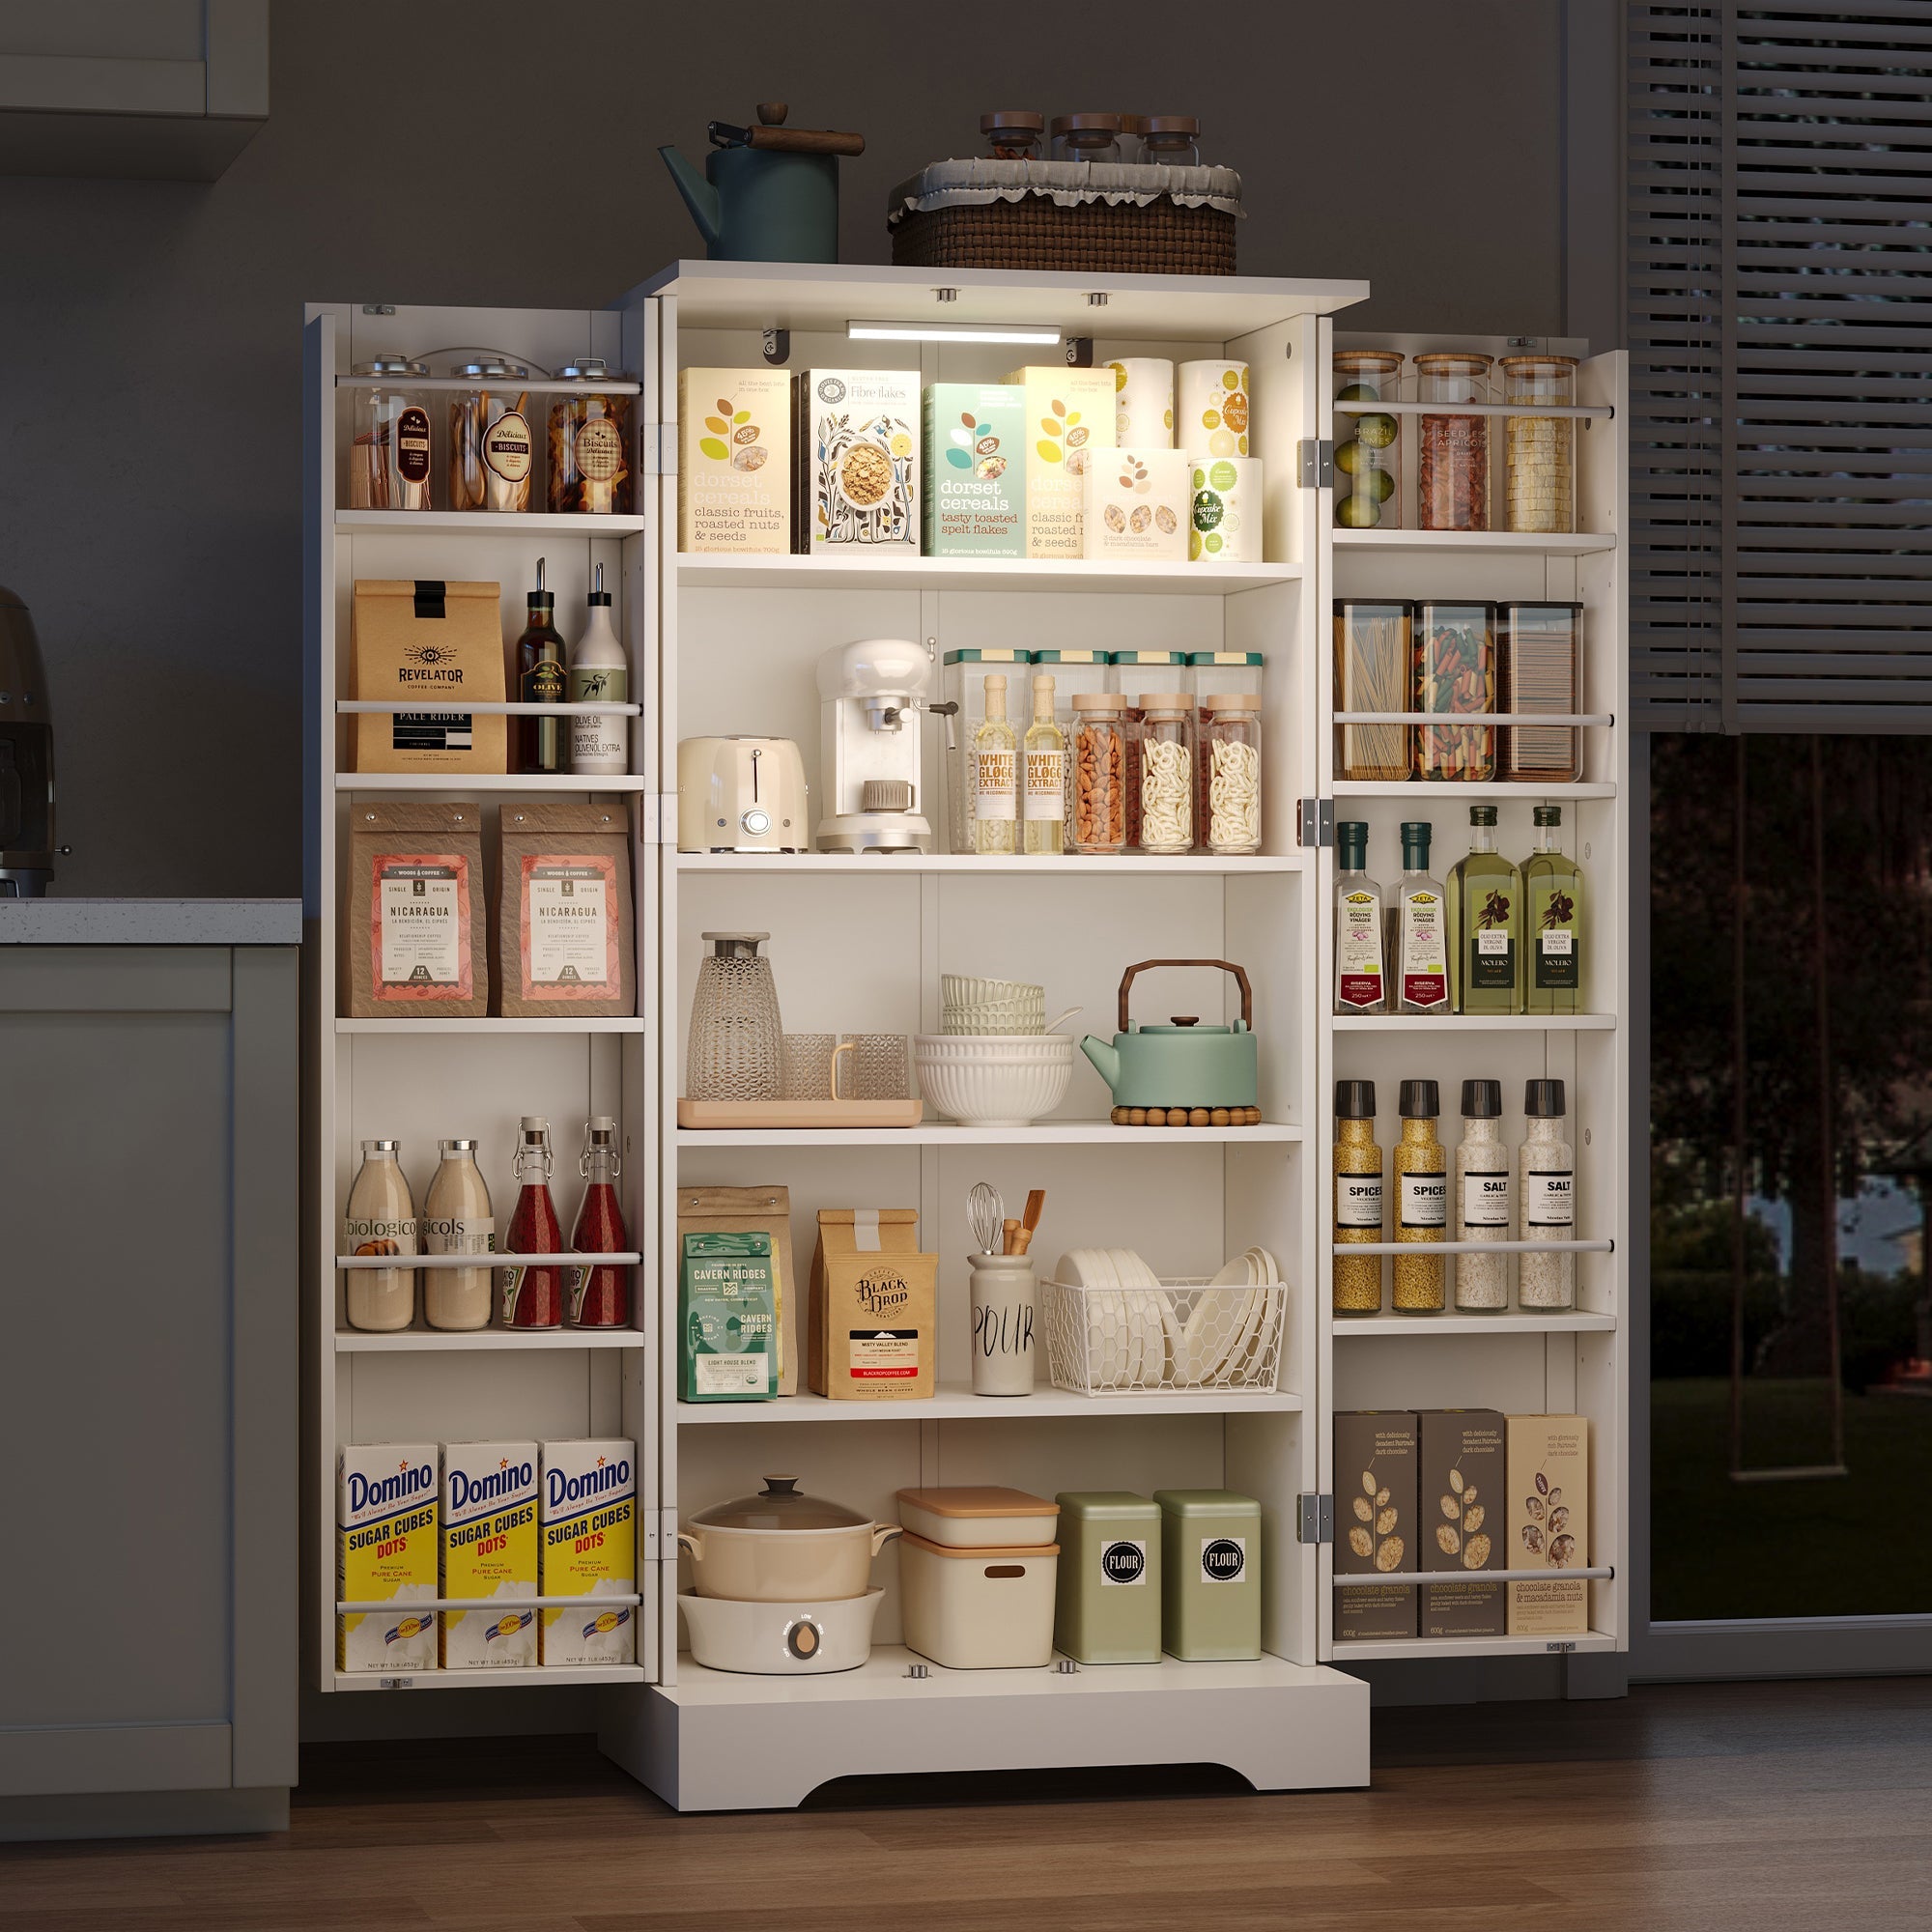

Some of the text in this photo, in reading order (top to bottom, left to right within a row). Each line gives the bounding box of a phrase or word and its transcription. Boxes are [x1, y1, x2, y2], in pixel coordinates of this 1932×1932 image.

[851, 386, 906, 398] Fibre flakes
[583, 439, 617, 447] Biscuits
[695, 471, 763, 488] dorset
[941, 480, 1001, 495] dorset
[695, 491, 771, 504] cereals
[941, 497, 1009, 510] cereals
[696, 507, 784, 520] classic fruits,
[1194, 503, 1221, 516] Cupcake
[942, 513, 1018, 524] tasty toasted
[1032, 513, 1071, 523] classic
[1200, 513, 1217, 525] Mix
[696, 520, 780, 529] roasted nuts
[942, 526, 1009, 535] spelt flakes
[1032, 526, 1080, 535] roasted
[696, 531, 746, 541] & seeds
[1032, 537, 1077, 547] & seeds
[399, 668, 463, 684] REVELATOR
[576, 734, 599, 743] NATIVES
[979, 754, 1012, 765] WHITE
[1027, 754, 1062, 766] WHITE
[390, 907, 448, 916] NICARAGUA
[1484, 1182, 1506, 1191] SALT
[1548, 1181, 1570, 1190] SALT
[695, 1269, 765, 1279] CAVERN RIDGES
[856, 1279, 906, 1301] BLACK
[871, 1293, 908, 1312] DROP
[741, 1324, 772, 1333] RIDGES
[974, 1303, 1036, 1356] POUR
[348, 1464, 432, 1512] Domino
[449, 1463, 532, 1510] Domino
[547, 1461, 629, 1508] Domino
[368, 1507, 385, 1516] Always
[469, 1504, 487, 1514] Always
[566, 1502, 583, 1511] Always
[350, 1509, 433, 1550] SUGAR CUBES
[450, 1507, 533, 1548] SUGAR CUBES
[548, 1504, 630, 1546] SUGAR CUBES
[378, 1537, 406, 1559] DOTS
[477, 1534, 506, 1557] DOTS
[576, 1532, 604, 1554] DOTS
[1110, 1555, 1138, 1569] FLOUR
[1209, 1553, 1237, 1567] FLOUR
[1343, 1584, 1410, 1596] chocolate granola
[1430, 1582, 1497, 1594] chocolate granola
[1517, 1581, 1580, 1593] chocolate granola
[1517, 1594, 1523, 1603] &
[1524, 1593, 1565, 1602] macadamia
